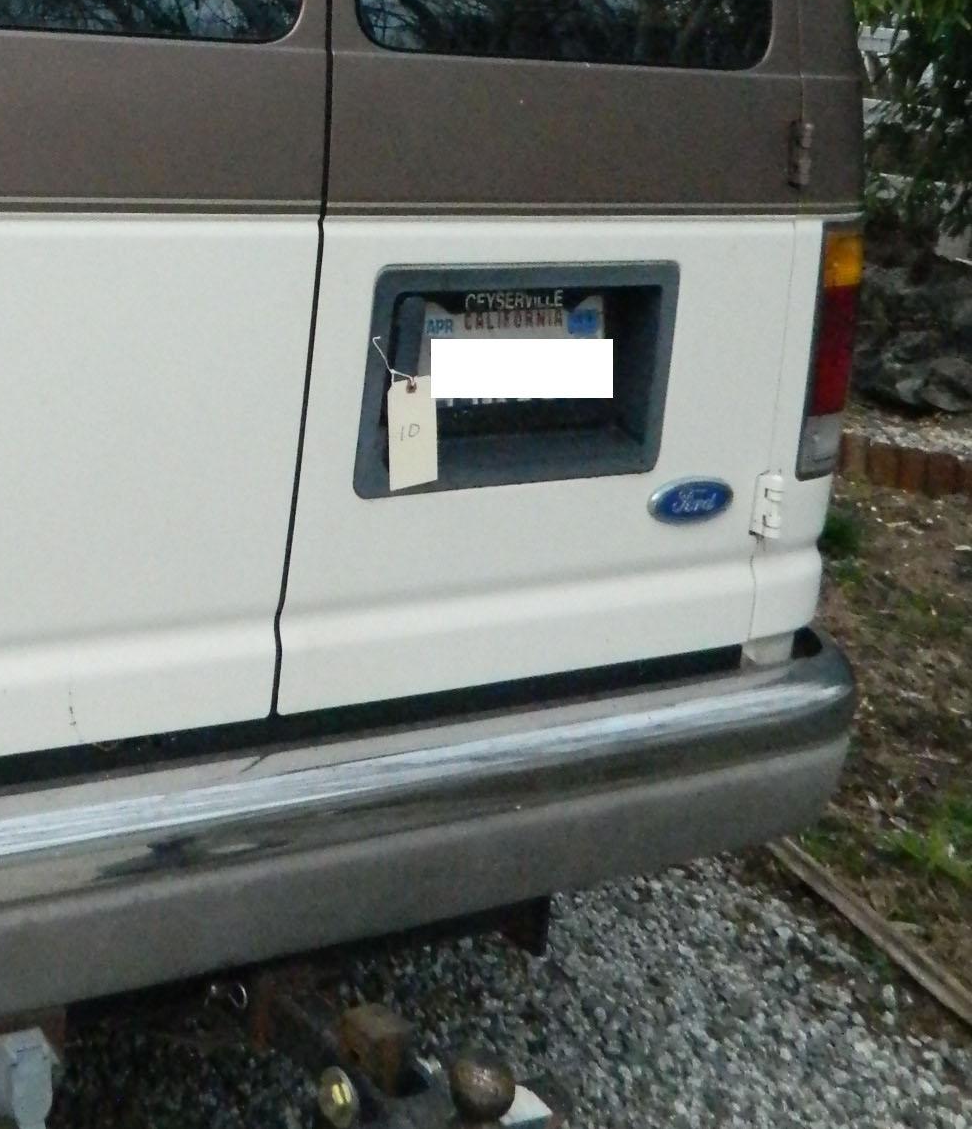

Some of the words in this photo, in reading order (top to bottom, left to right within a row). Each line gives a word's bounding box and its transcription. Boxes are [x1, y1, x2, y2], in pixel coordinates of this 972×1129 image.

[426, 318, 454, 334] APR
[464, 310, 564, 330] CALIFORNIA
[671, 488, 717, 513] Ford
